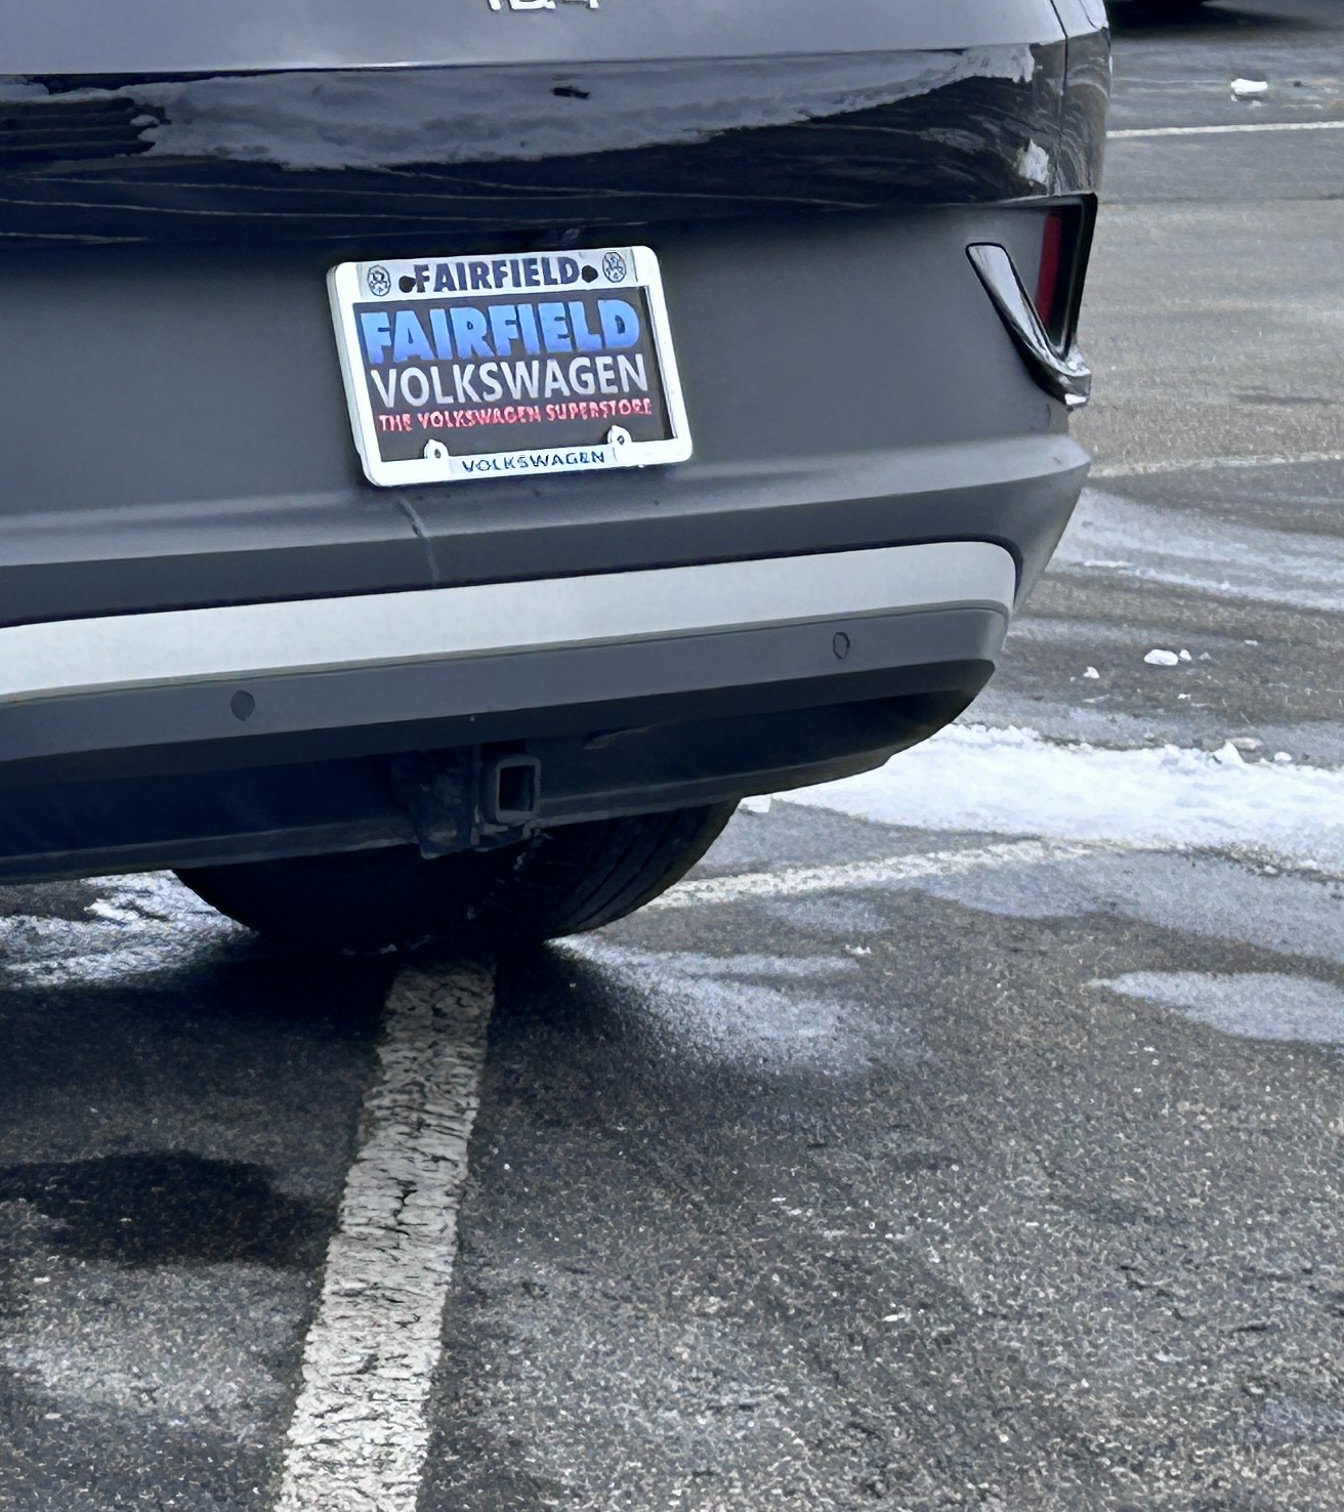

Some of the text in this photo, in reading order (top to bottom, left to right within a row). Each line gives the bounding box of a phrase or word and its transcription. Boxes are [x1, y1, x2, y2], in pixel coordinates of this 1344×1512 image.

[414, 256, 580, 293] FAIRFIELD
[360, 299, 640, 364] FAIRFIELD
[370, 354, 649, 408] VOLKSWAGEN
[379, 398, 652, 432] THE VOLKSWAGEN SUPERSTORE
[462, 451, 606, 473] VOLKSWAGEN
